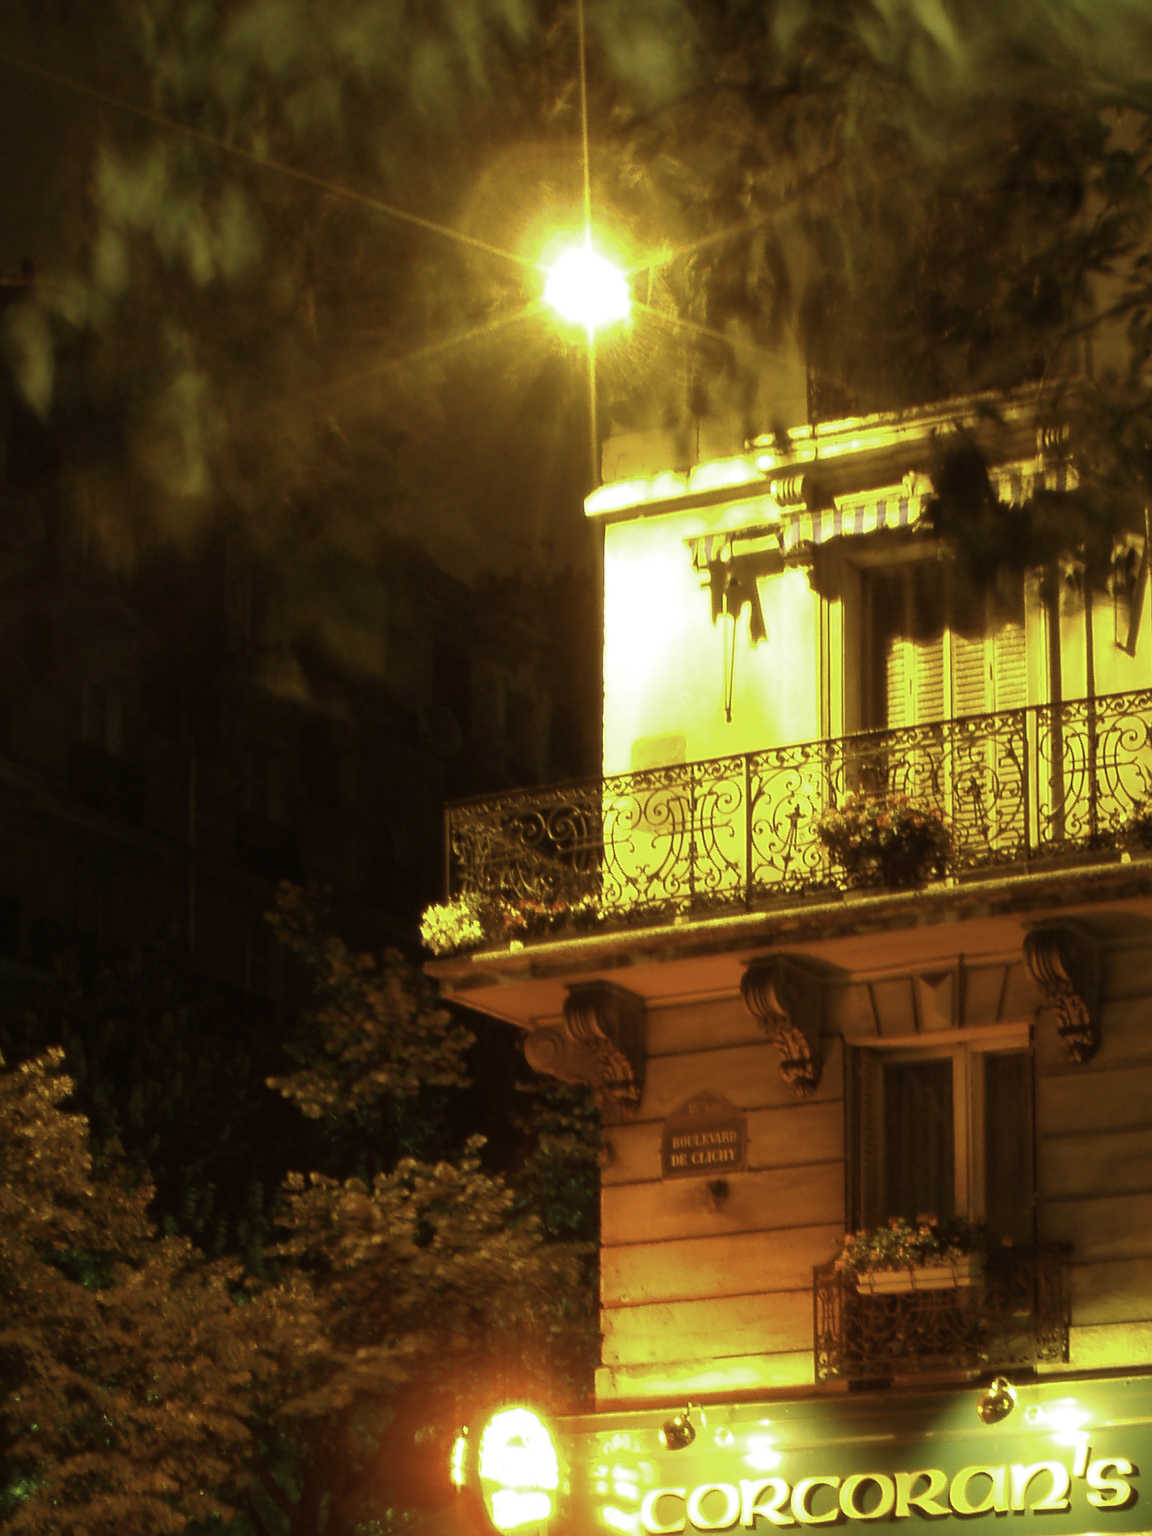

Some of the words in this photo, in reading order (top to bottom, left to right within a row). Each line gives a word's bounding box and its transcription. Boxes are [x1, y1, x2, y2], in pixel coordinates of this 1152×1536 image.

[673, 1131, 737, 1149] BOULEVARD
[671, 1153, 687, 1167] DE
[691, 1148, 734, 1165] CLICHY
